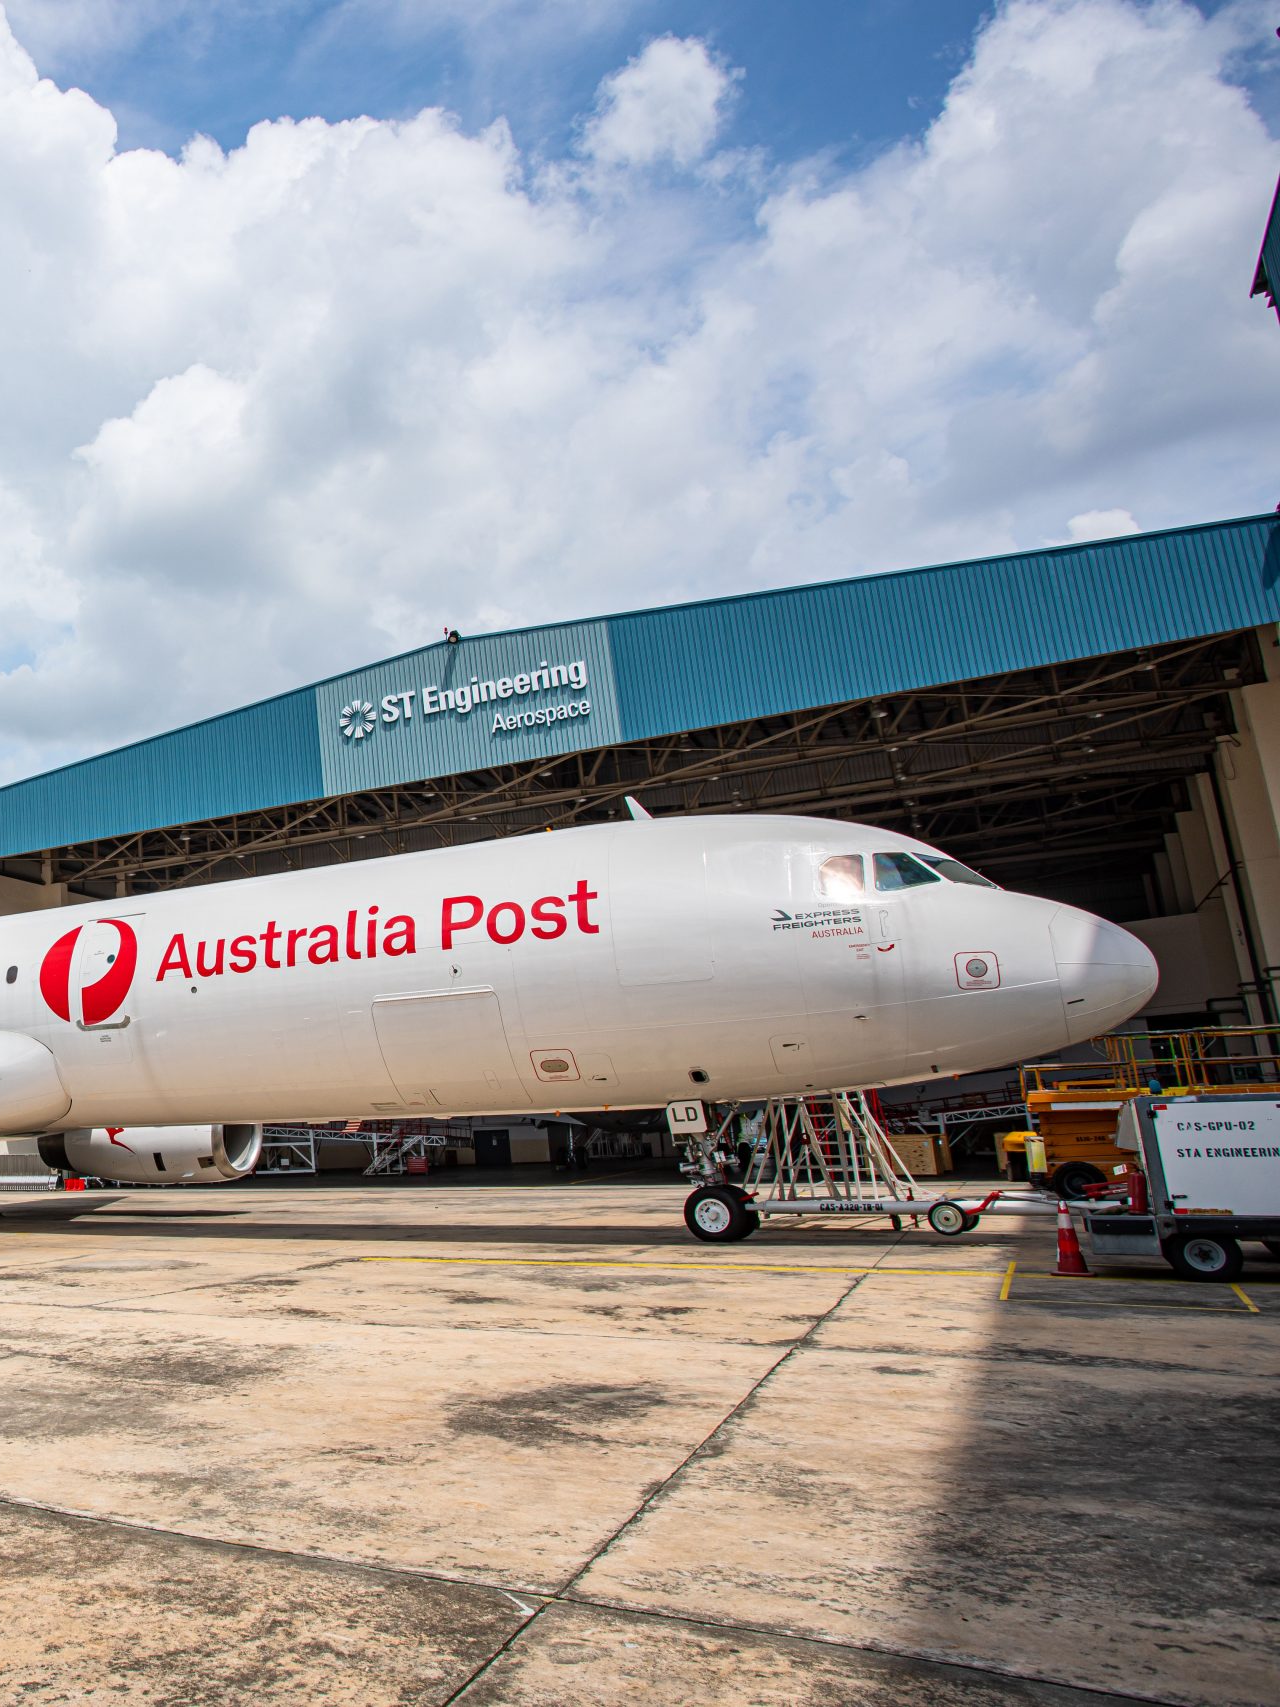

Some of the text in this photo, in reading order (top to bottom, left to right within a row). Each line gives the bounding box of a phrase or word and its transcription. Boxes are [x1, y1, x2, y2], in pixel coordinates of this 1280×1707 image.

[381, 660, 589, 722] ST Engineering
[492, 700, 591, 733] Aerospace
[795, 908, 860, 920] EXPRESS
[156, 880, 601, 982] Australia Post
[773, 916, 862, 931] FREIGHTERS
[811, 926, 864, 939] AUSTRALIA
[671, 1106, 698, 1123] LD
[1176, 1148, 1202, 1158] STA
